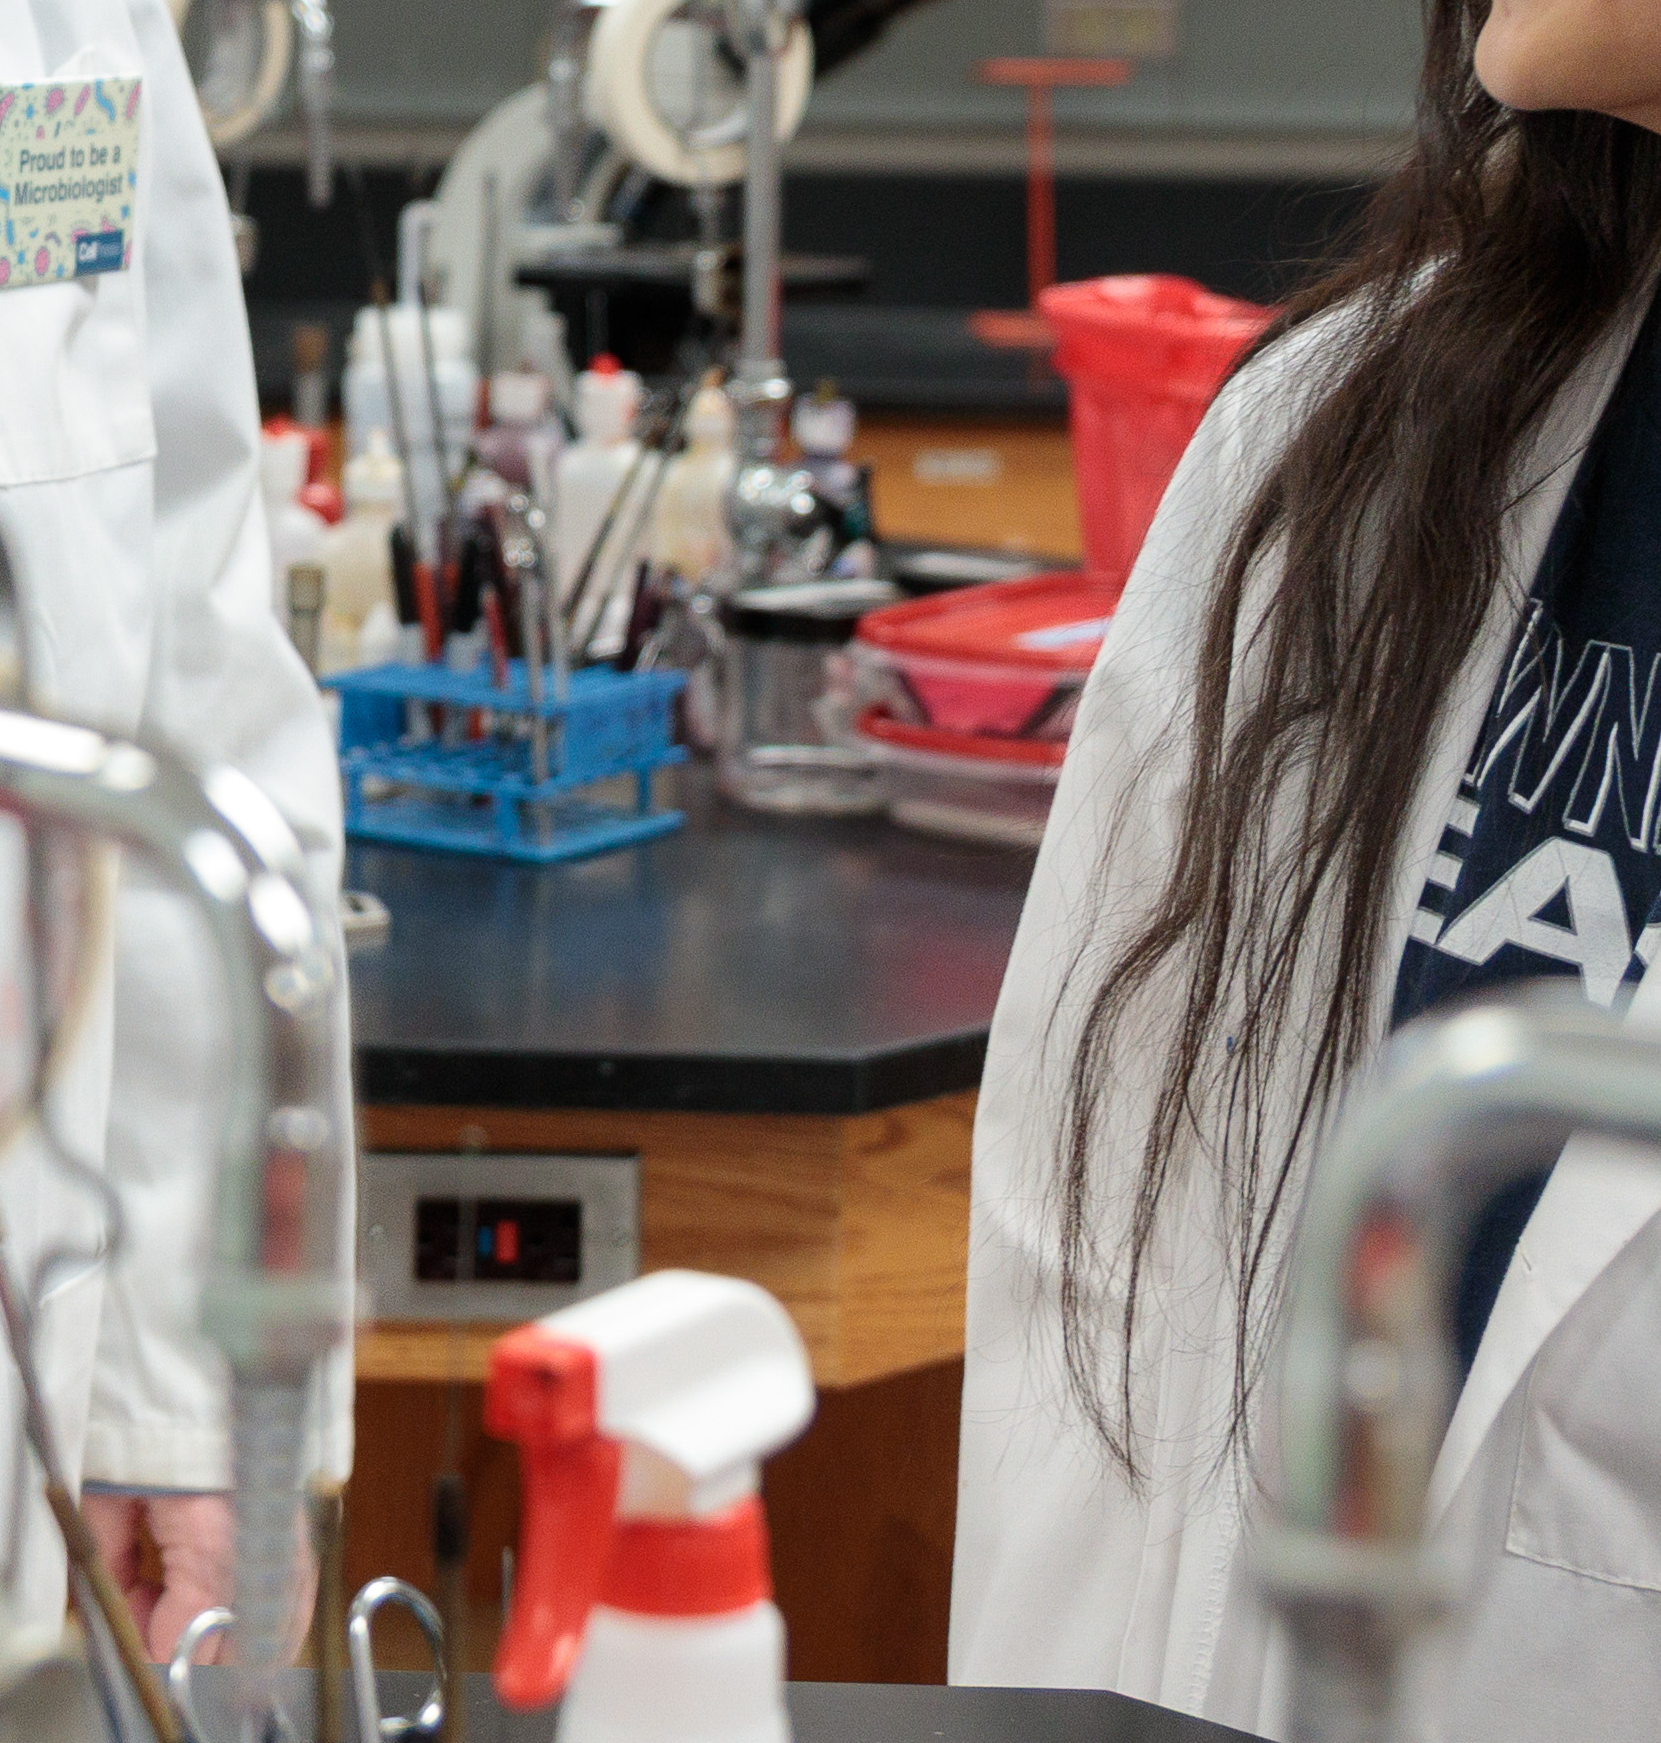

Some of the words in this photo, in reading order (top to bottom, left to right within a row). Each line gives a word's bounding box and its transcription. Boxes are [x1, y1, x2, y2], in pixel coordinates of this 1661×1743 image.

[20, 145, 65, 173] Proud
[70, 146, 85, 168] to
[89, 142, 107, 166] be
[113, 145, 121, 164] a
[14, 172, 123, 206] Microbiologist
